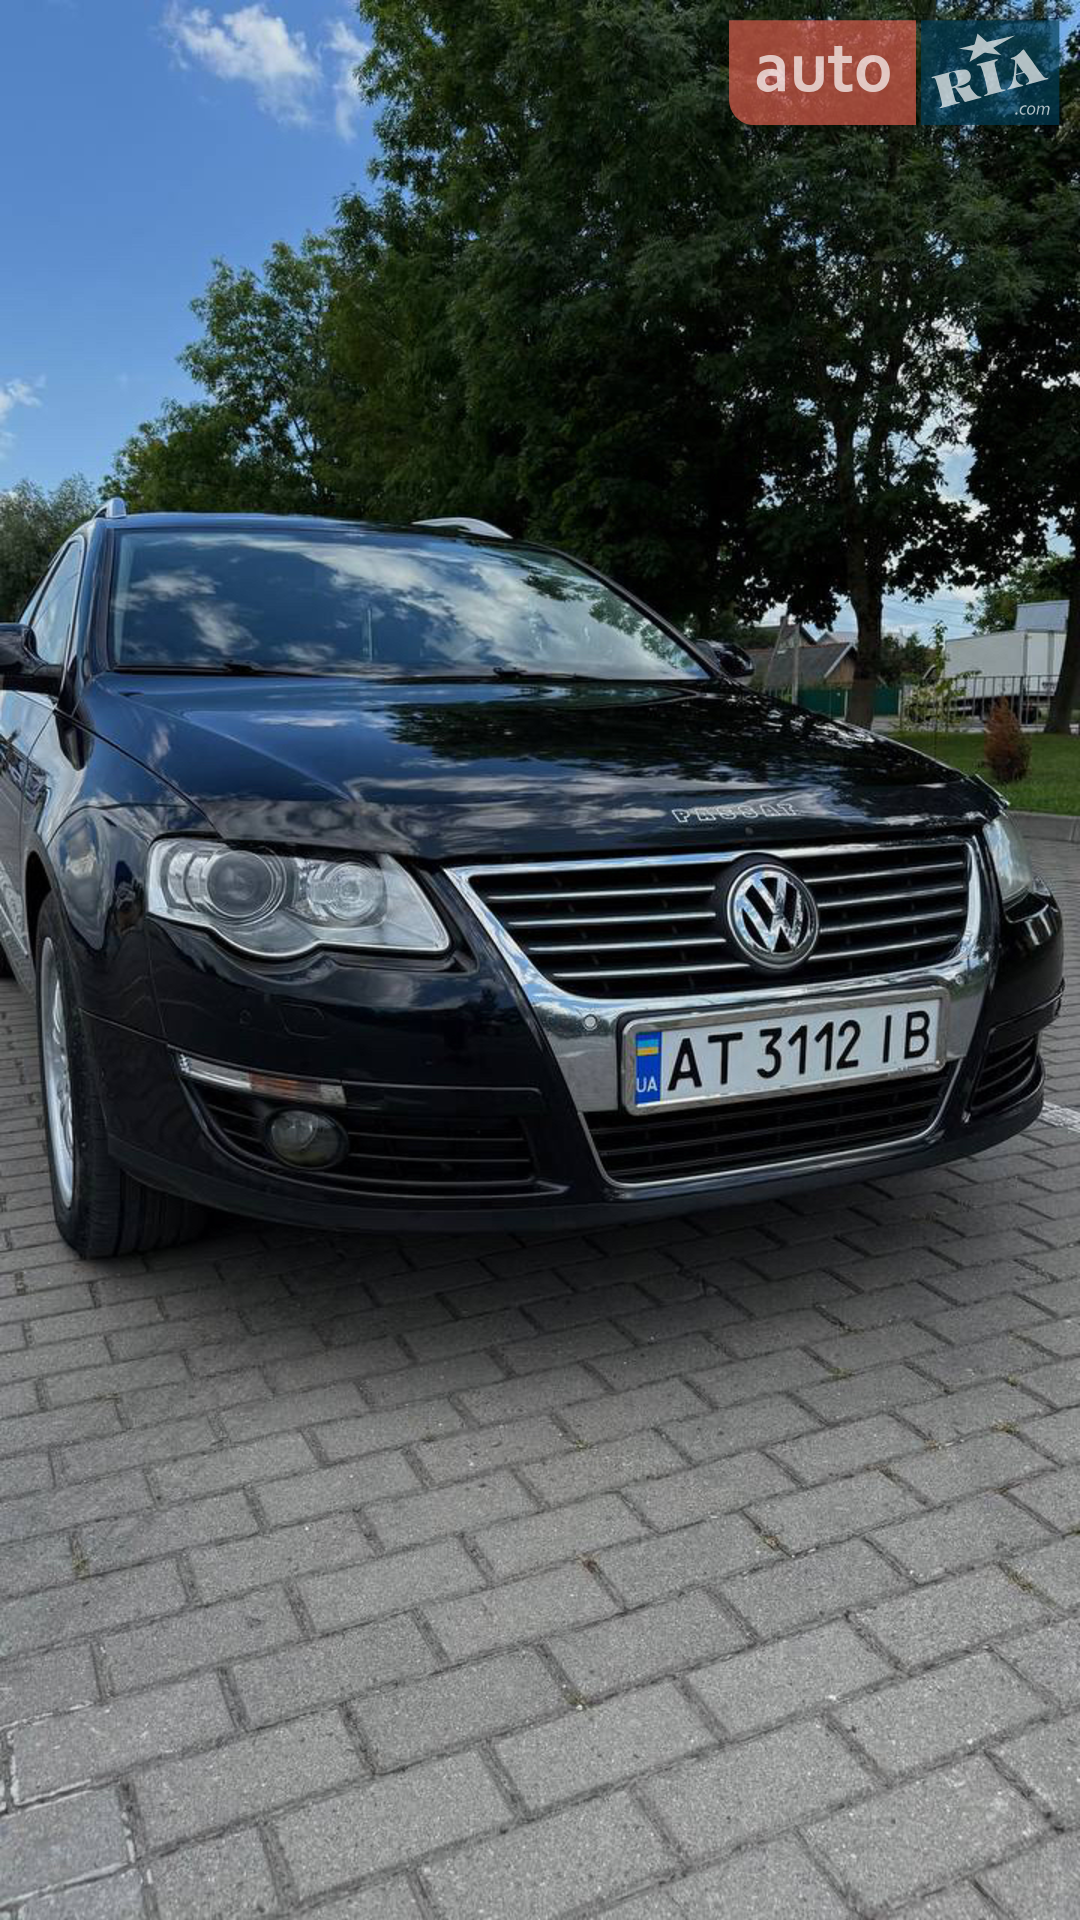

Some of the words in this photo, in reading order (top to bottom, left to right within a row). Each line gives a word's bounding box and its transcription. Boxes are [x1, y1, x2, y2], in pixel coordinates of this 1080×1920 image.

[671, 804, 798, 823] PASSAT
[667, 1032, 743, 1091] AT
[757, 1020, 861, 1079] 3112
[882, 1010, 931, 1063] IB
[635, 1076, 658, 1092] UA
